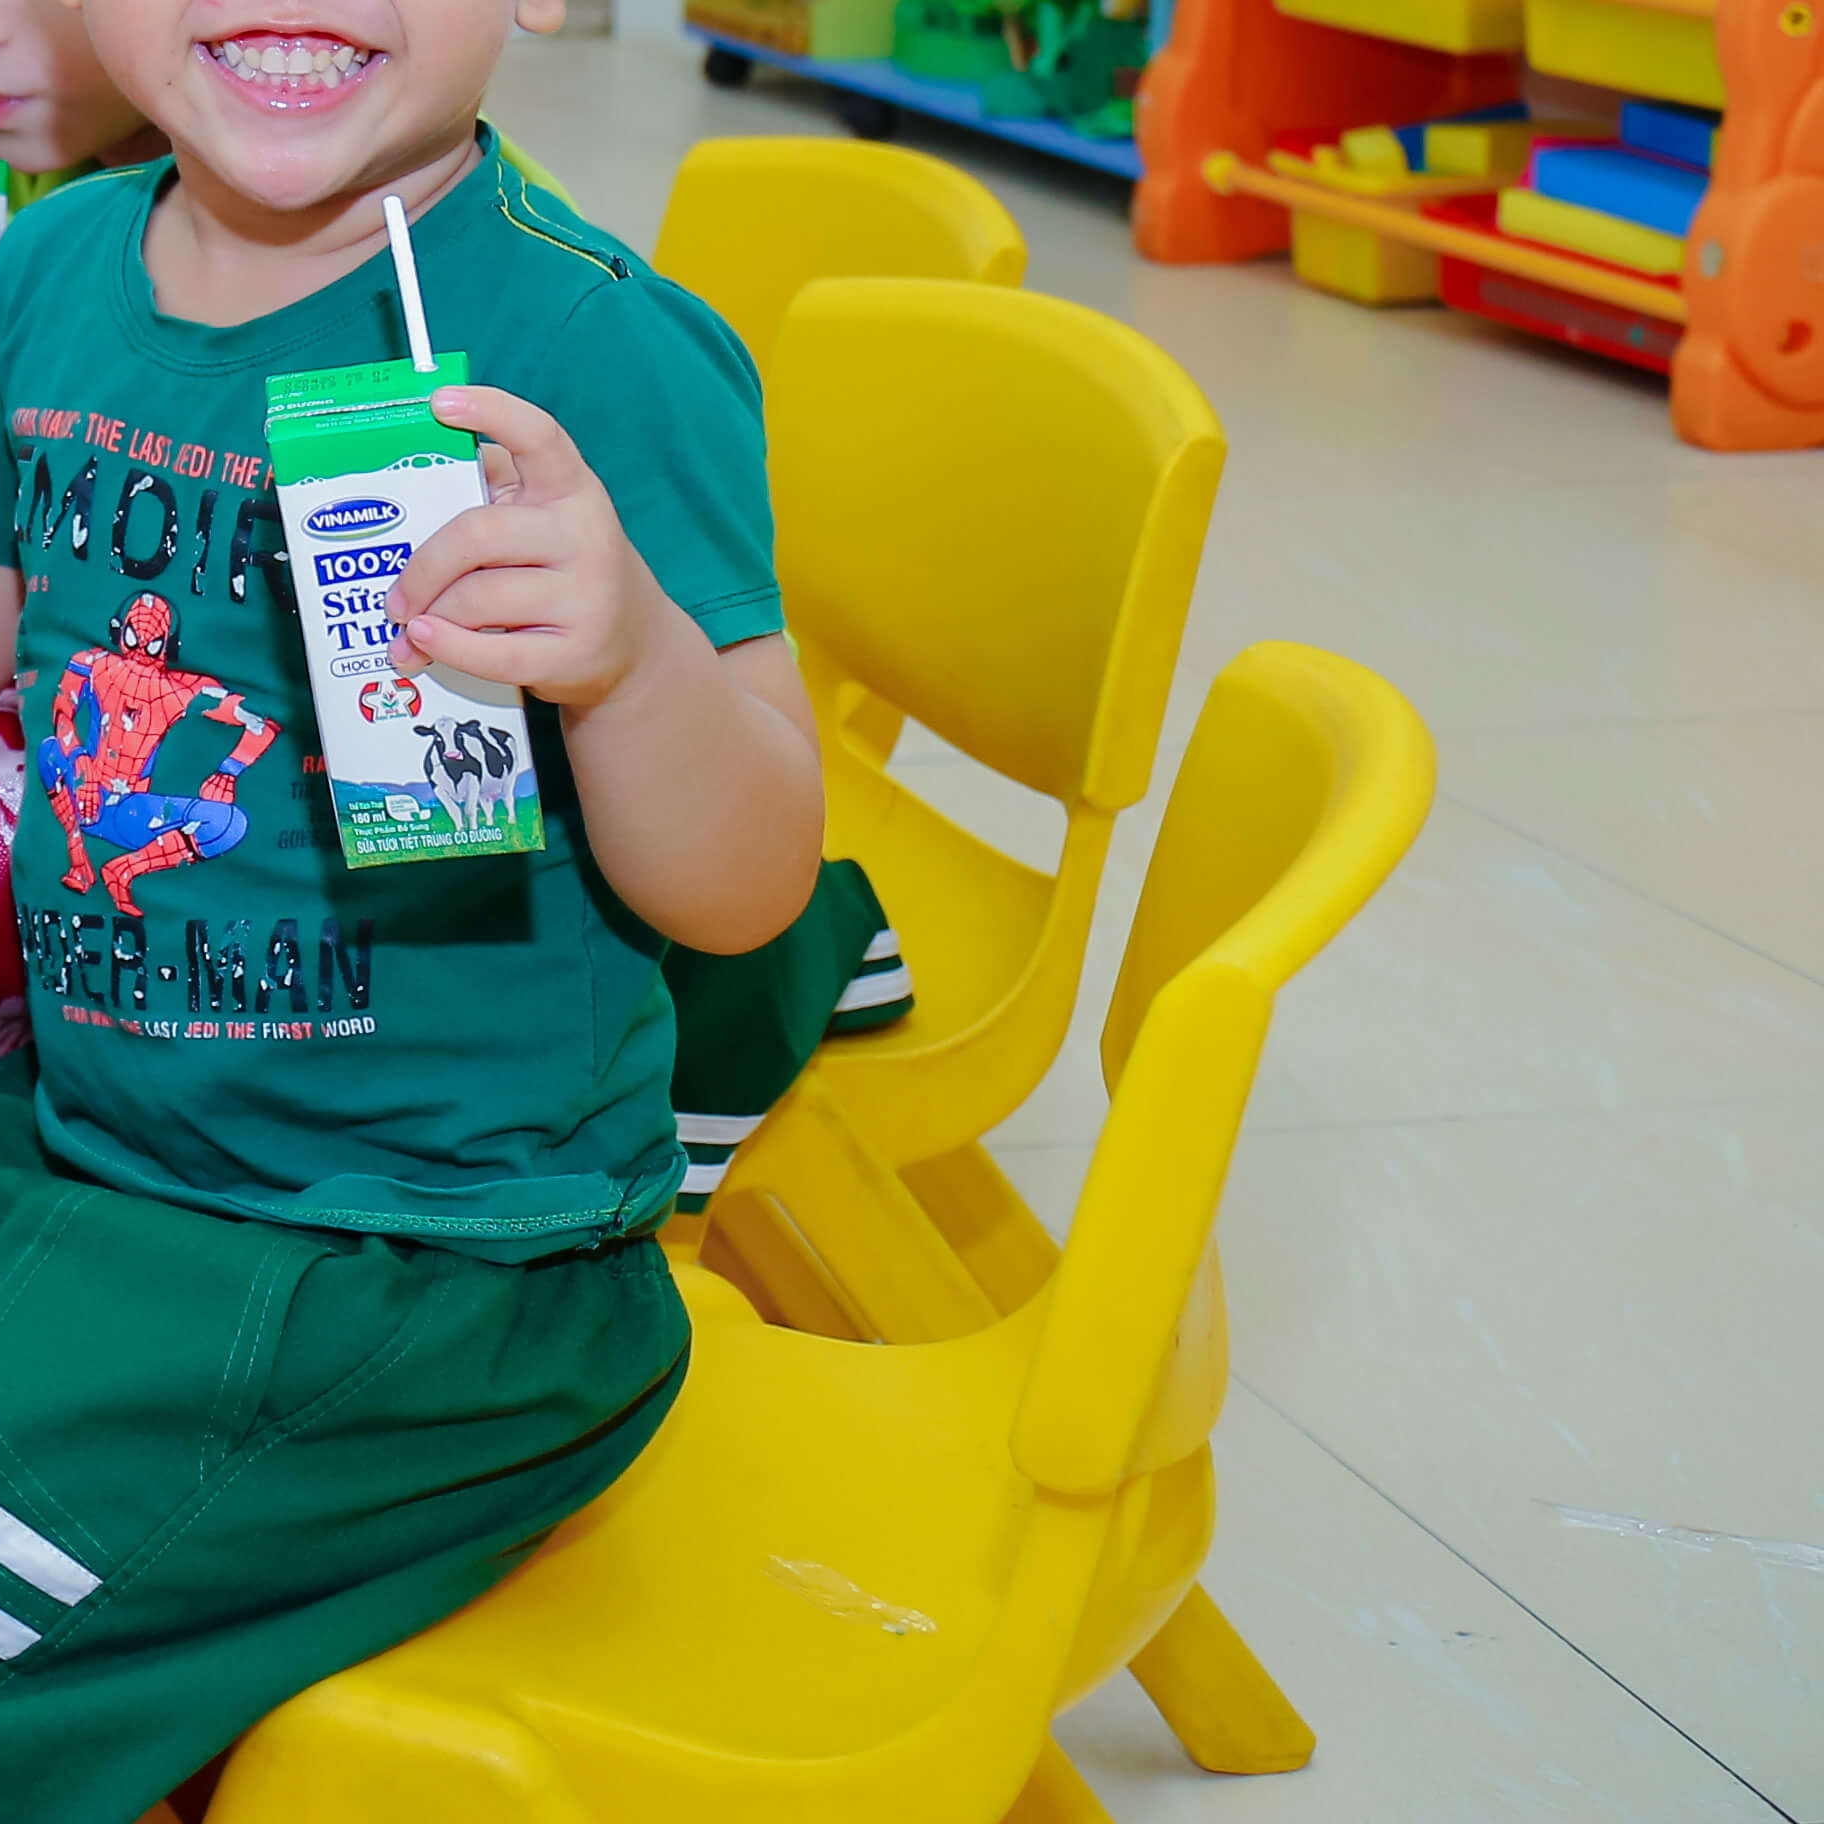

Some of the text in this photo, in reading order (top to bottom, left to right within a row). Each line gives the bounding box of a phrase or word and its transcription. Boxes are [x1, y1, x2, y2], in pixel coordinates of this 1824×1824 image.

[85, 412, 126, 453] THE
[221, 452, 263, 489] THE
[313, 505, 395, 528] VINAMILK
[320, 547, 407, 580] 100%
[372, 810, 386, 822] ml
[145, 1021, 179, 1039] LAST
[184, 1021, 220, 1039] JEDI
[225, 1021, 255, 1039] THE
[263, 1022, 313, 1040] FIRST
[321, 1016, 376, 1039] WORD
